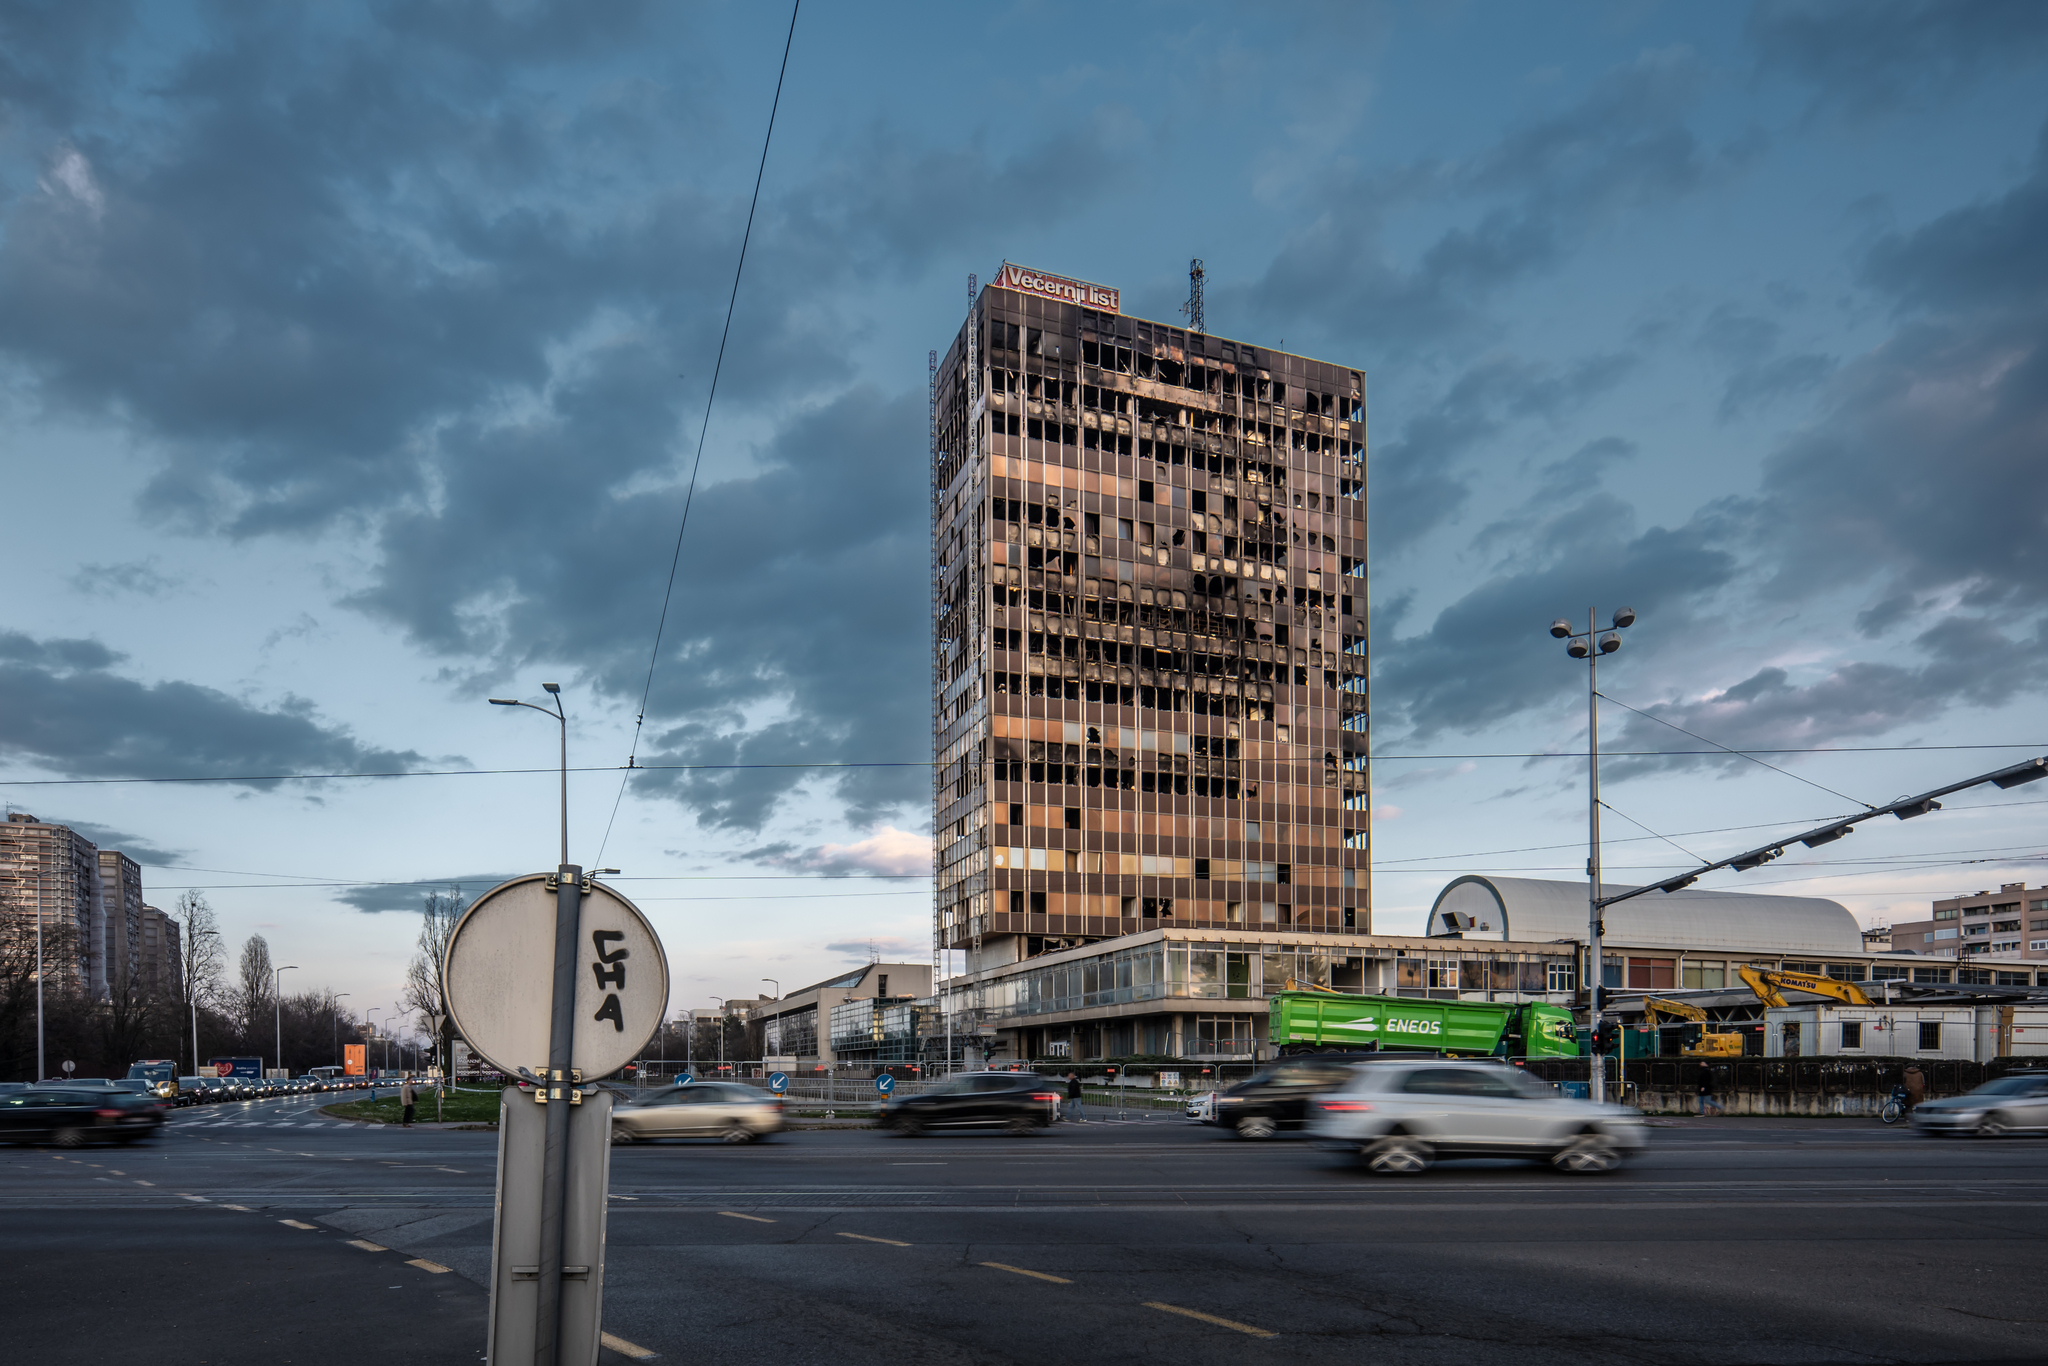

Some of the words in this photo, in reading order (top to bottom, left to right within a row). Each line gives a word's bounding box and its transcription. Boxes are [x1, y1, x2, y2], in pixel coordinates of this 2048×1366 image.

[1008, 266, 1085, 303] Večernji
[1089, 287, 1118, 308] list
[1780, 978, 1817, 989] KOMATSU
[1386, 1018, 1441, 1035] ENEOS
